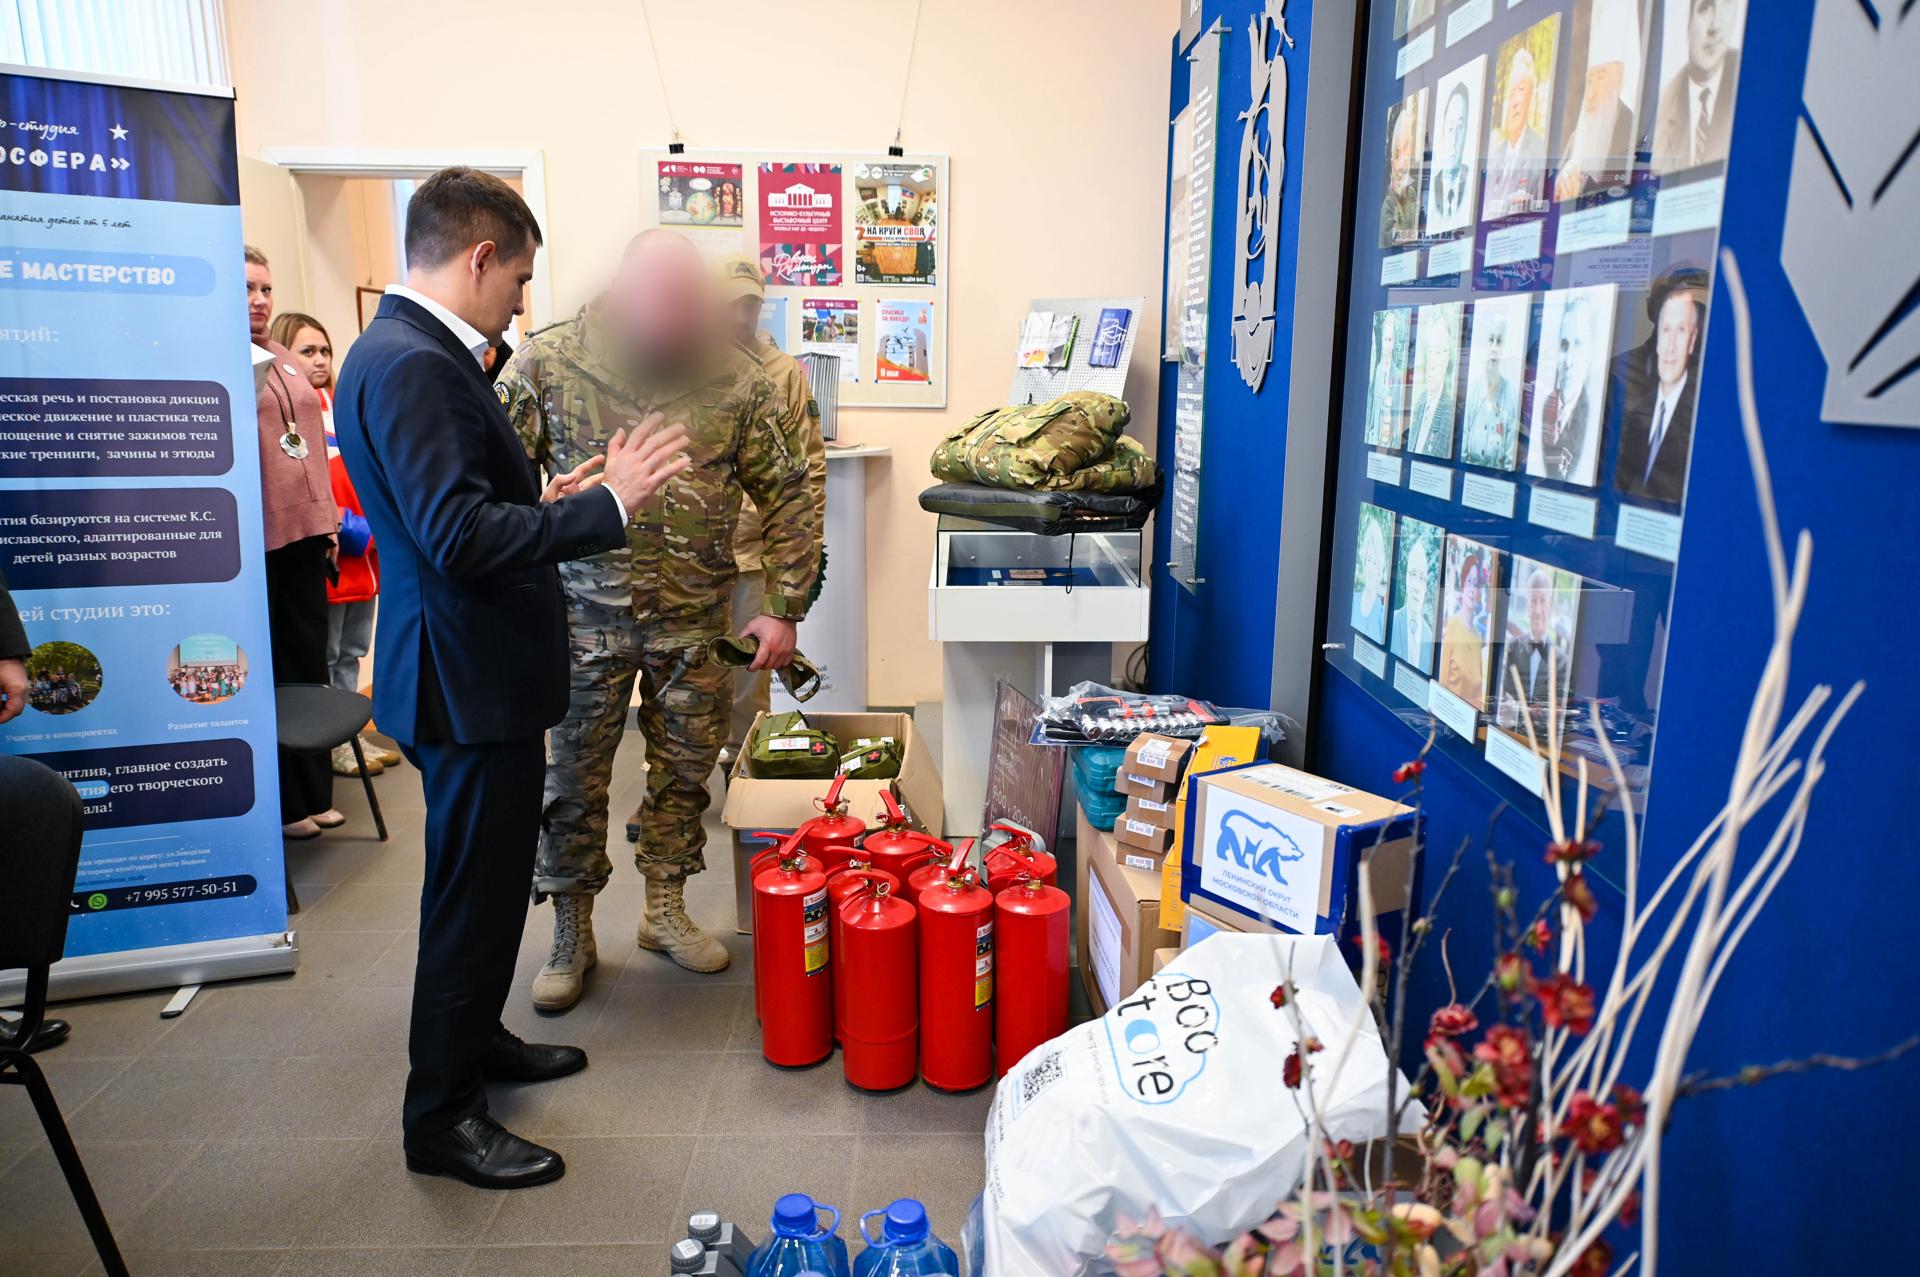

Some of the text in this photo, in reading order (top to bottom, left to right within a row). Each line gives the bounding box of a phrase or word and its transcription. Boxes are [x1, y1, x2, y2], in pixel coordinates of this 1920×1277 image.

[46, 216, 80, 229] детей
[83, 218, 98, 226] от
[102, 219, 107, 227] 5
[111, 220, 131, 228] лет
[867, 227, 926, 236] НА КРУГИ СВОЯ
[22, 261, 176, 286] МАСТЕРСТВО
[42, 394, 73, 405] речь
[77, 394, 86, 403] и
[90, 394, 166, 405] постановка
[169, 395, 219, 406] дикции
[44, 413, 112, 423] движение
[116, 413, 125, 422] и
[128, 412, 188, 423] пластика
[192, 413, 220, 423] тела
[65, 432, 75, 441] и
[77, 432, 124, 441] снятие
[128, 432, 186, 441] зажимов
[189, 431, 218, 441] тела
[31, 450, 100, 461] тренинги,
[107, 450, 156, 459] зачины
[160, 450, 169, 459] и
[172, 449, 215, 460] этюды
[30, 514, 111, 527] базируются
[114, 516, 130, 524] на
[134, 514, 187, 523] системе
[190, 511, 216, 522] К.С.
[83, 530, 196, 544] адаптированные
[199, 530, 223, 540] для
[13, 549, 177, 564] детей разных возрастов
[51, 605, 124, 624] студии
[130, 603, 171, 617] это:
[168, 718, 249, 731] Развитие талантов
[115, 762, 171, 776] главное
[174, 756, 228, 771] создать
[110, 783, 134, 796] его
[137, 775, 223, 793] творческого
[125, 881, 238, 904] +7 995 577-50-51
[1223, 870, 1291, 903] ЛЕНИНСКИЙ ОКРУГ
[1213, 877, 1298, 919] МОСКОВСКОЙ ОБЛАСТИ
